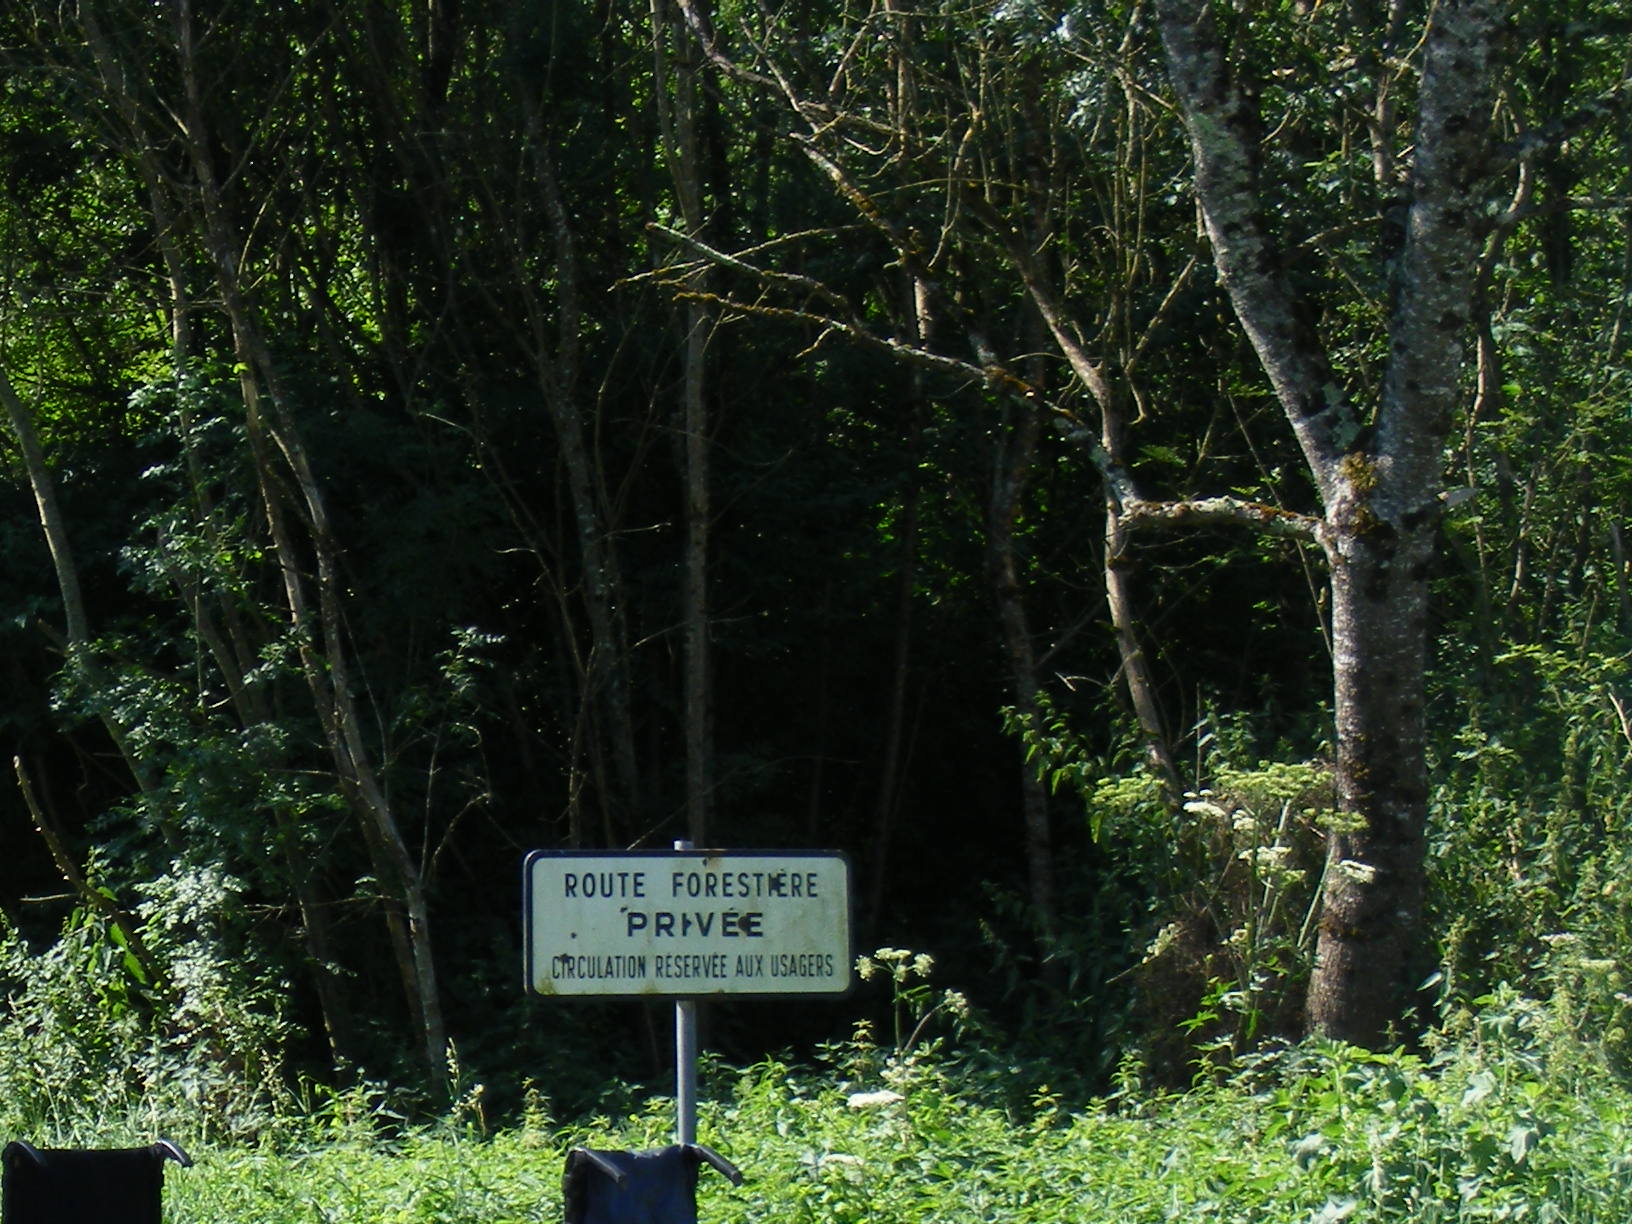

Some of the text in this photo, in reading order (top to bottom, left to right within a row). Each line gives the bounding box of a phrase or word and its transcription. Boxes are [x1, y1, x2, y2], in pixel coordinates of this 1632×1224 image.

[564, 868, 819, 898] ROUTE FORESTIÈRE
[626, 907, 764, 938] PRIVÉE
[551, 954, 646, 979] CIRCULATION
[735, 954, 764, 977] AUX
[770, 953, 834, 977] USAGERS
